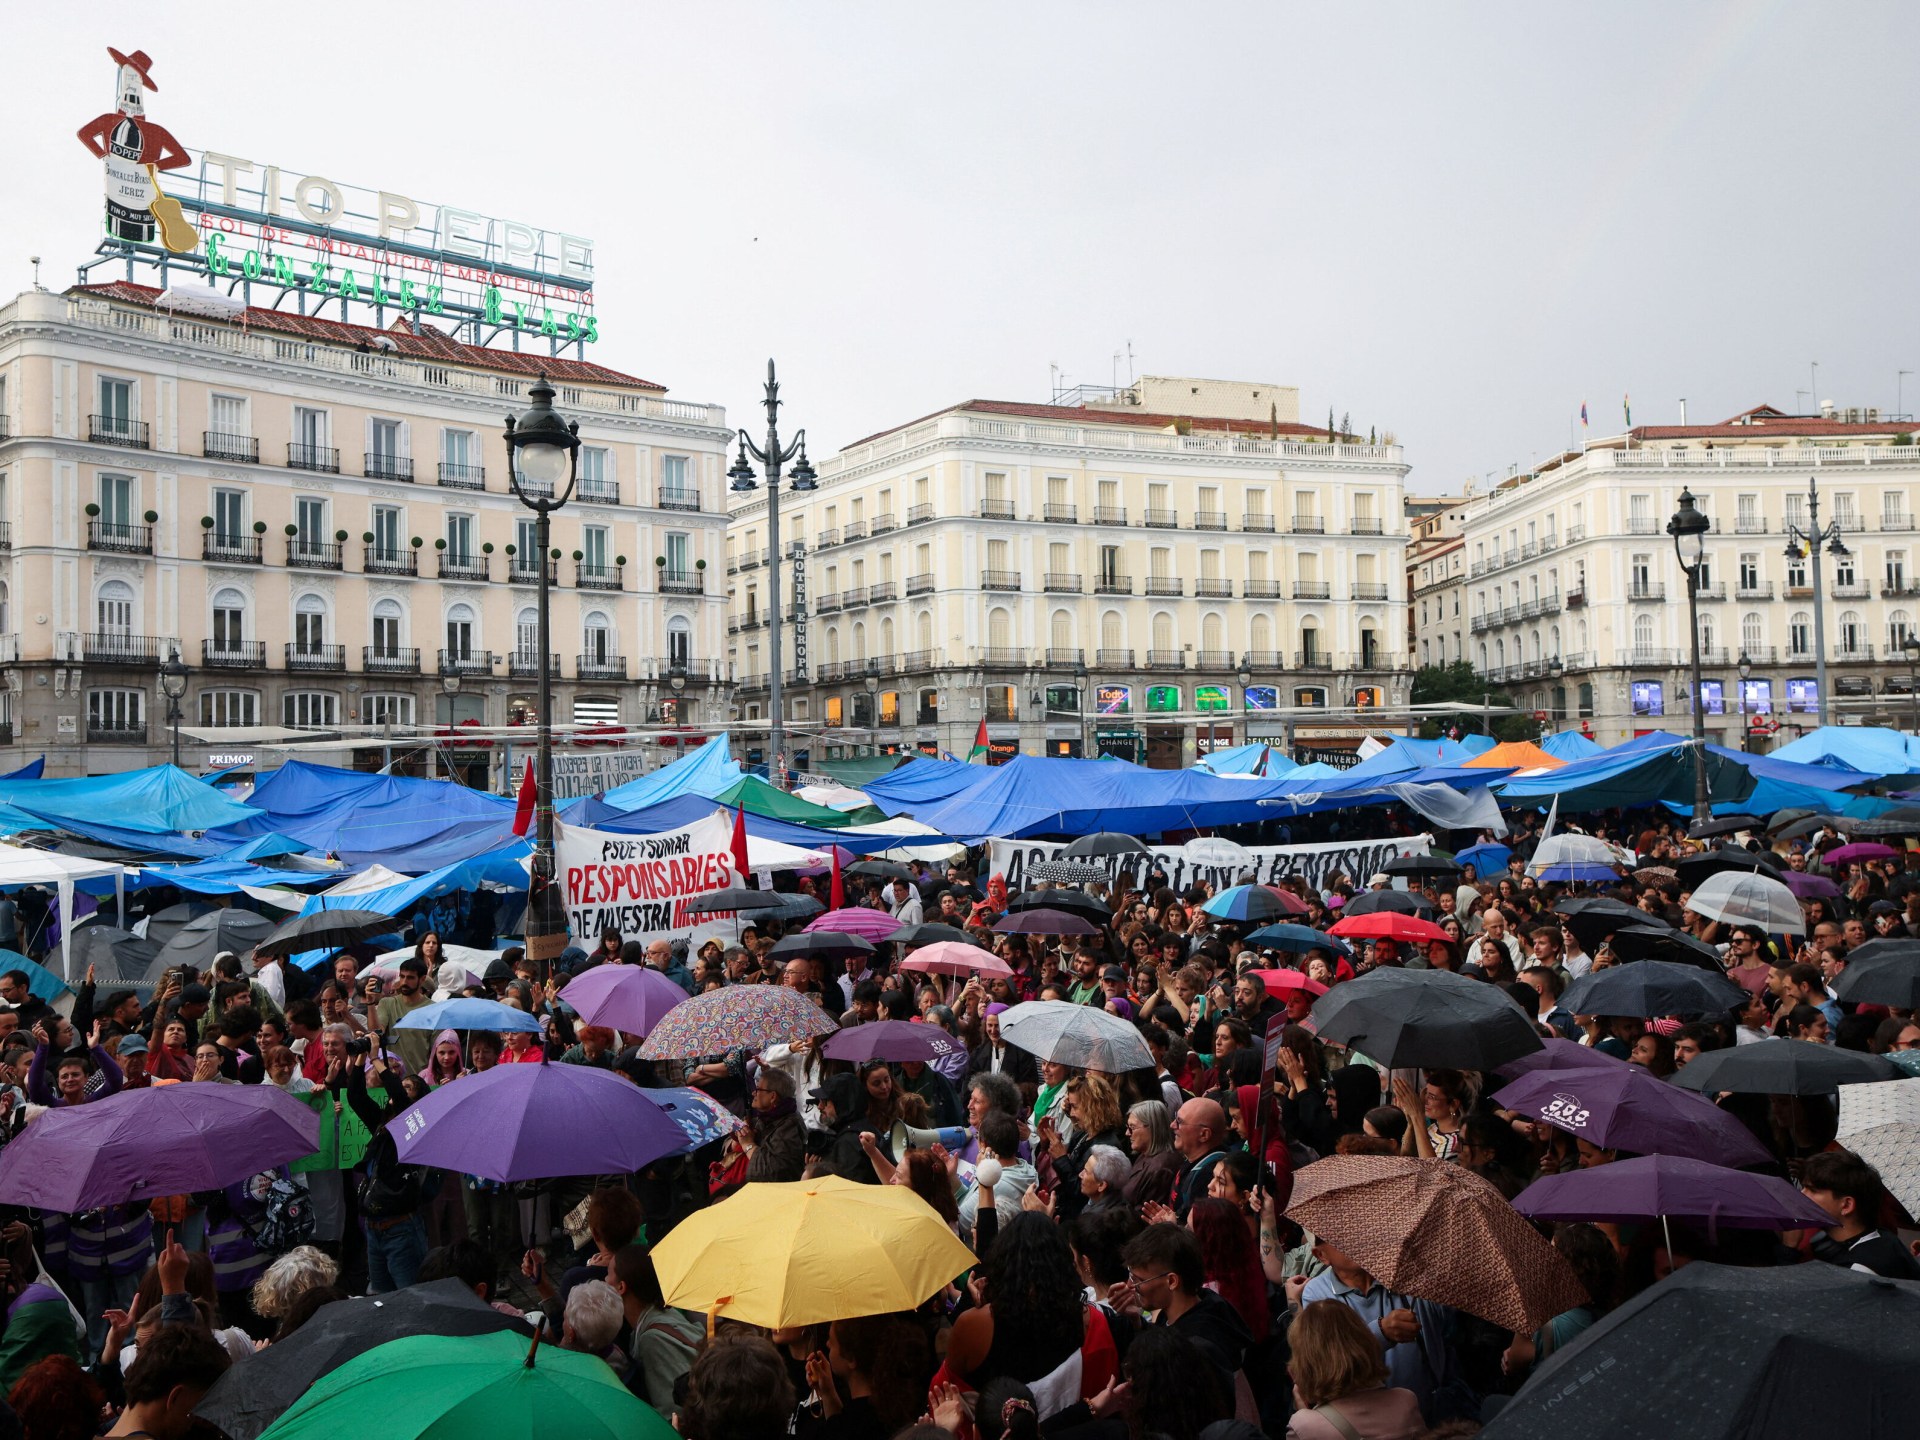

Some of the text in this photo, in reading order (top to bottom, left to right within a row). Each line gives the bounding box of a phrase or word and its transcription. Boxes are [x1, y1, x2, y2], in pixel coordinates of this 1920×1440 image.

[119, 185, 145, 198] JEREZ
[110, 204, 127, 217] FINO
[205, 151, 594, 282] TIO PEPE
[200, 213, 594, 305] SOL DE ANDALUCIA EMBOTELLADO
[207, 233, 598, 343] GONZALEZ BYASS
[794, 549, 806, 679] HOTEL EUROPA
[1098, 689, 1124, 699] Todo
[1314, 730, 1340, 738] CASA
[1346, 730, 1359, 738] DE
[920, 746, 937, 755] Orange
[990, 744, 1015, 753] Orange
[602, 833, 690, 861] PSOE Y SUMAR
[568, 852, 731, 905] RESPONSABLES
[593, 901, 671, 938] NUESTRA
[344, 1120, 352, 1136] A
[342, 1144, 353, 1161] ES
[1542, 1356, 1616, 1411] INESIS
